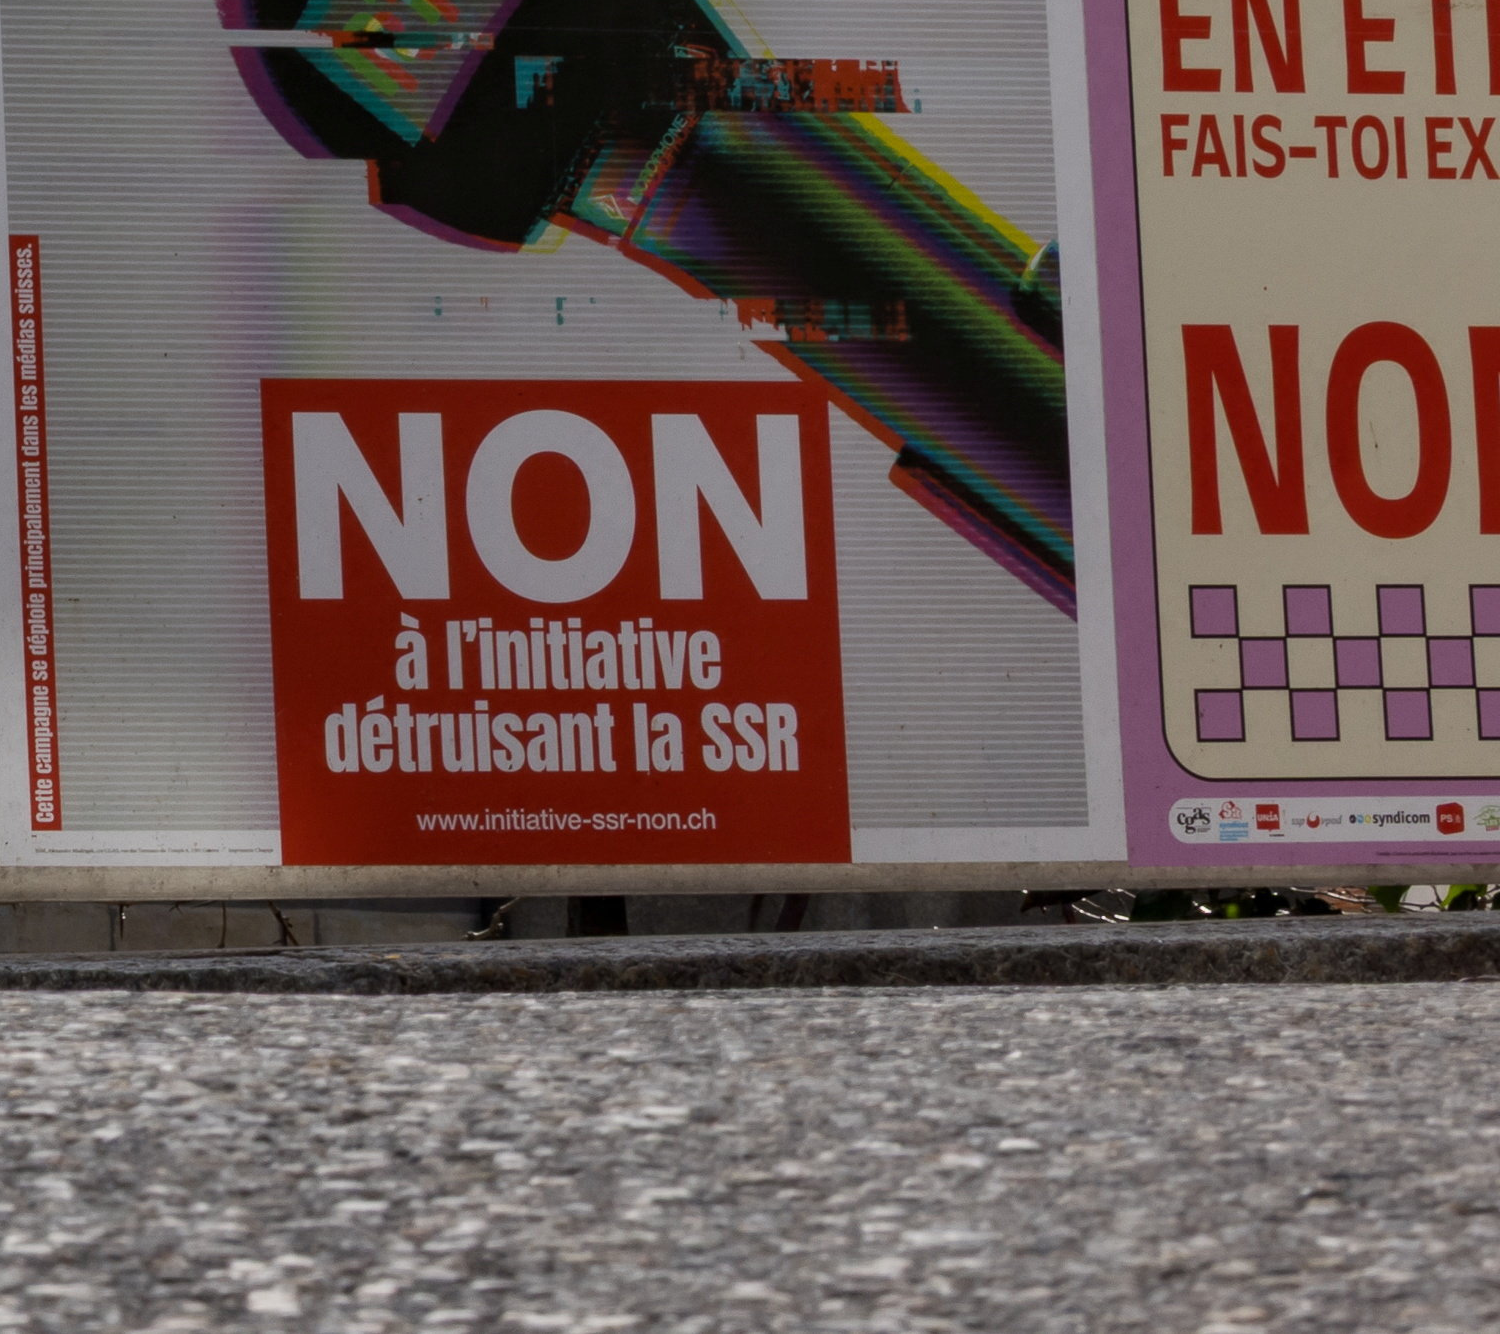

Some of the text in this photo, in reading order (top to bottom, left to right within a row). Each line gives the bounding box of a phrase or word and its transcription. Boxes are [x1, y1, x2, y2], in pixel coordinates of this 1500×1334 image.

[1160, 112, 1409, 181] FAIS-TOI
[1181, 320, 1500, 540] NO
[13, 243, 55, 823] Cette campagne se déploie principalement dans les médias suisses.
[291, 408, 809, 604] NON
[395, 612, 722, 690] à l'initiative
[324, 695, 800, 773] détruisant la SSR
[416, 808, 717, 832] www.initiative-ssr-non.ch
[1372, 810, 1430, 828] syndicom
